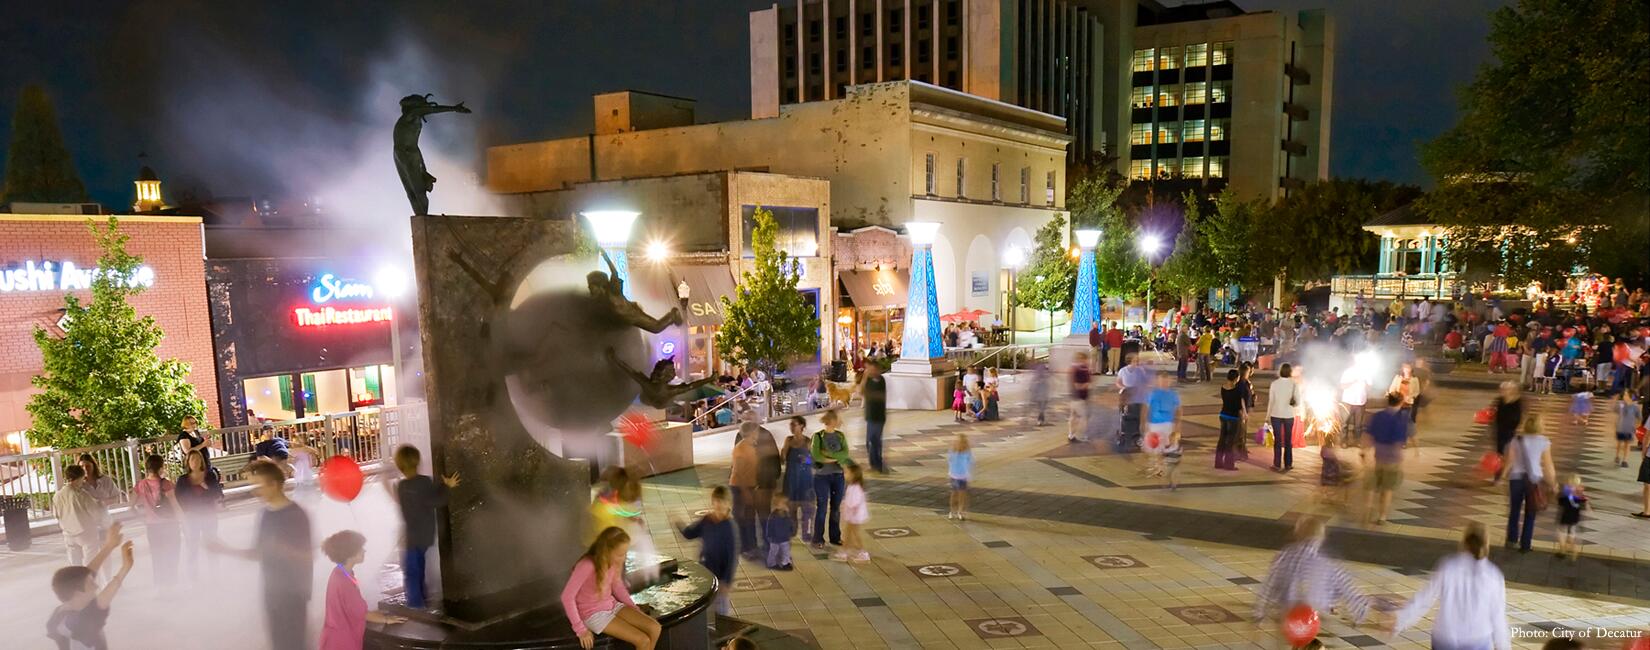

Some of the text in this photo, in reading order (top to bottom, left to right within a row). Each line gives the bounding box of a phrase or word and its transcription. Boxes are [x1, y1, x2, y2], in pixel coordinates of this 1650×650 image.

[313, 273, 374, 303] Siam
[295, 307, 392, 326] Thai Restaurant
